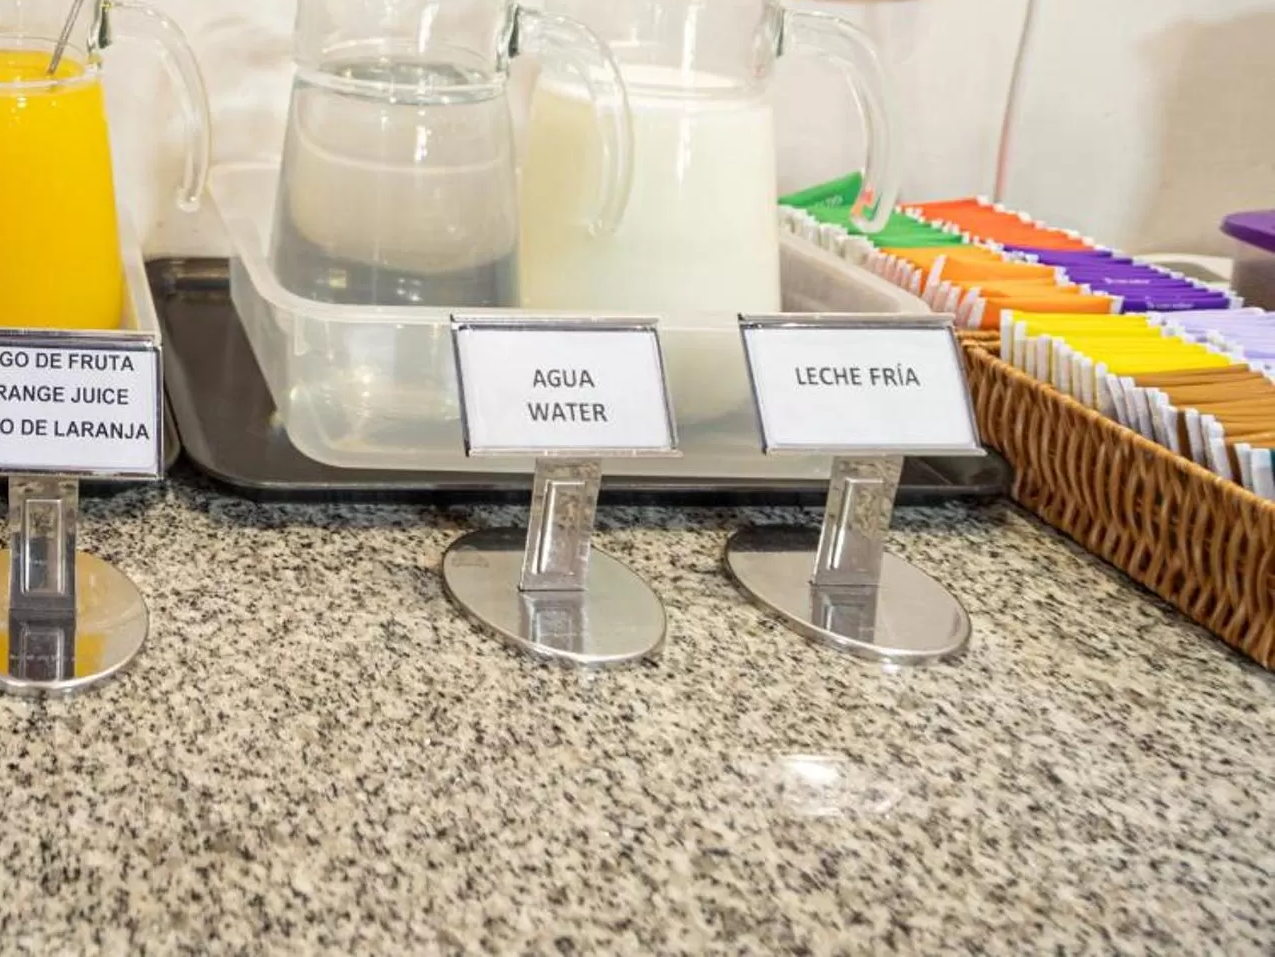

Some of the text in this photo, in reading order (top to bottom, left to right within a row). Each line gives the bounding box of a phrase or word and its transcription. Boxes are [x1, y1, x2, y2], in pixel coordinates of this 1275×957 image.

[35, 352, 62, 369] DE
[68, 353, 134, 371] FRUTA
[532, 369, 595, 388] AGUA
[795, 363, 921, 386] LECHE FRÍA
[71, 387, 129, 405] JUICE
[528, 402, 608, 422] WATER
[21, 418, 48, 436] DE
[54, 420, 150, 440] LARANJA
